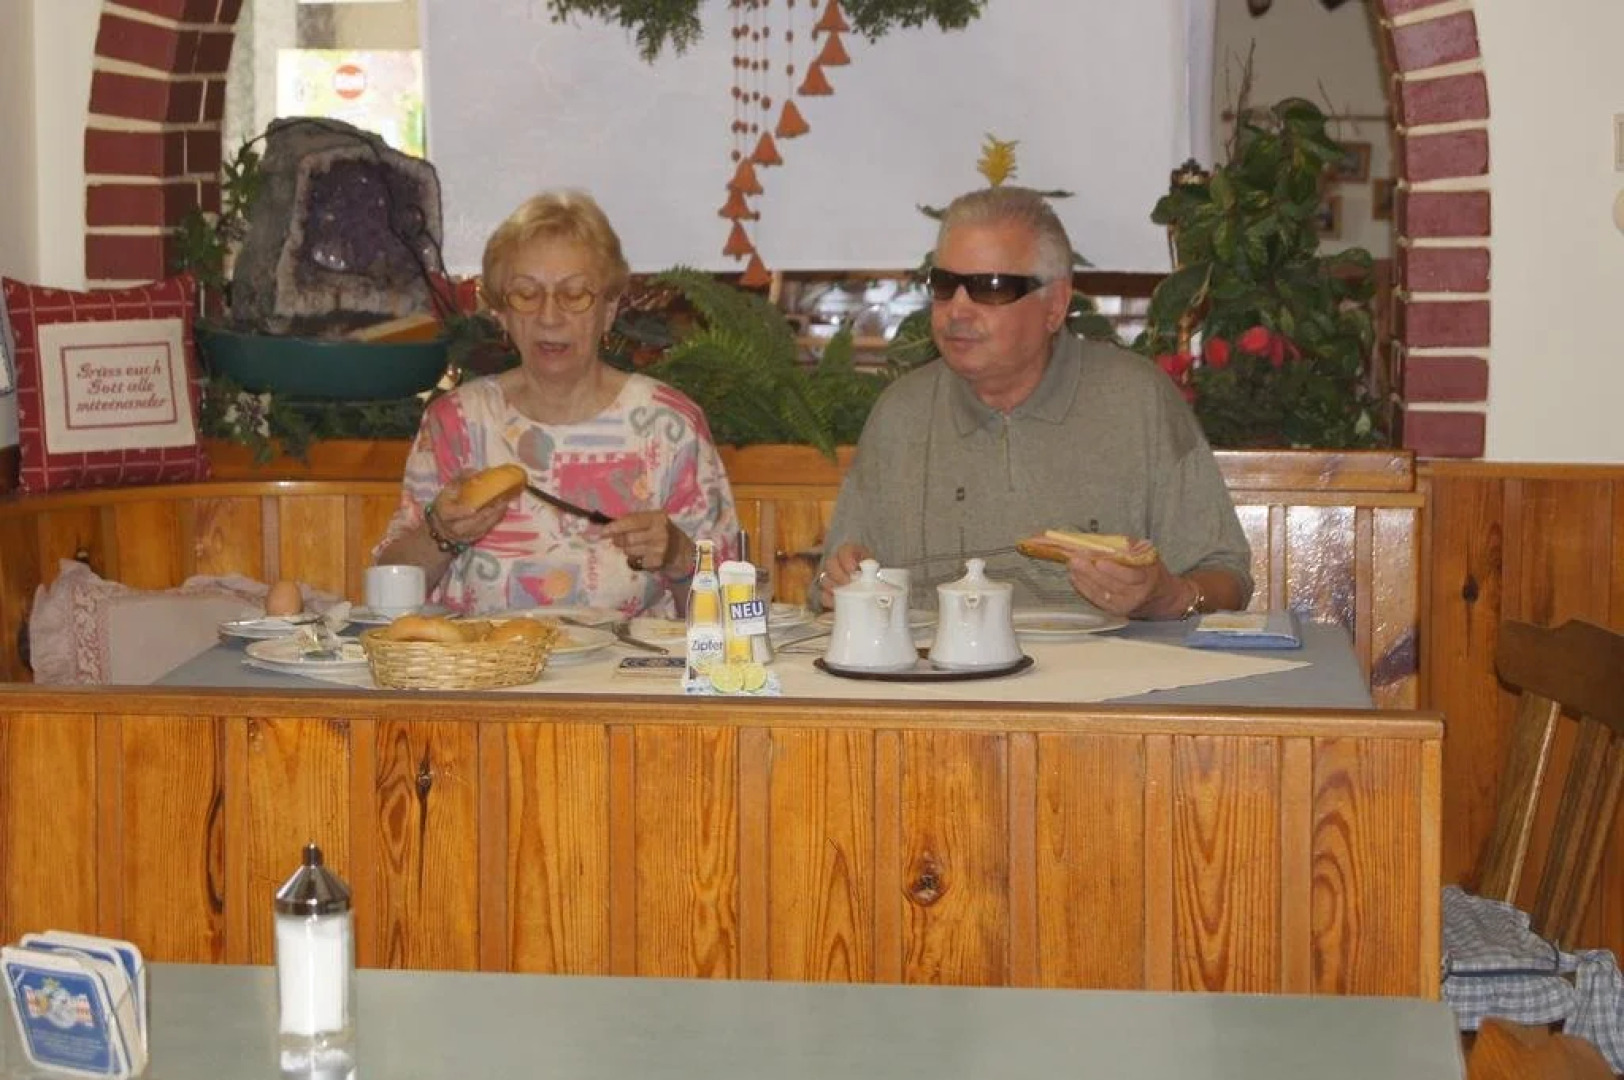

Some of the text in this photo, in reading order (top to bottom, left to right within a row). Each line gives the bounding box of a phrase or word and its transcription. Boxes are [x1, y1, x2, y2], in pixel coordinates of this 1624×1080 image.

[127, 359, 161, 376] euch
[87, 379, 123, 394] Gott
[731, 601, 764, 618] NEU
[692, 639, 723, 651] Zipfer
